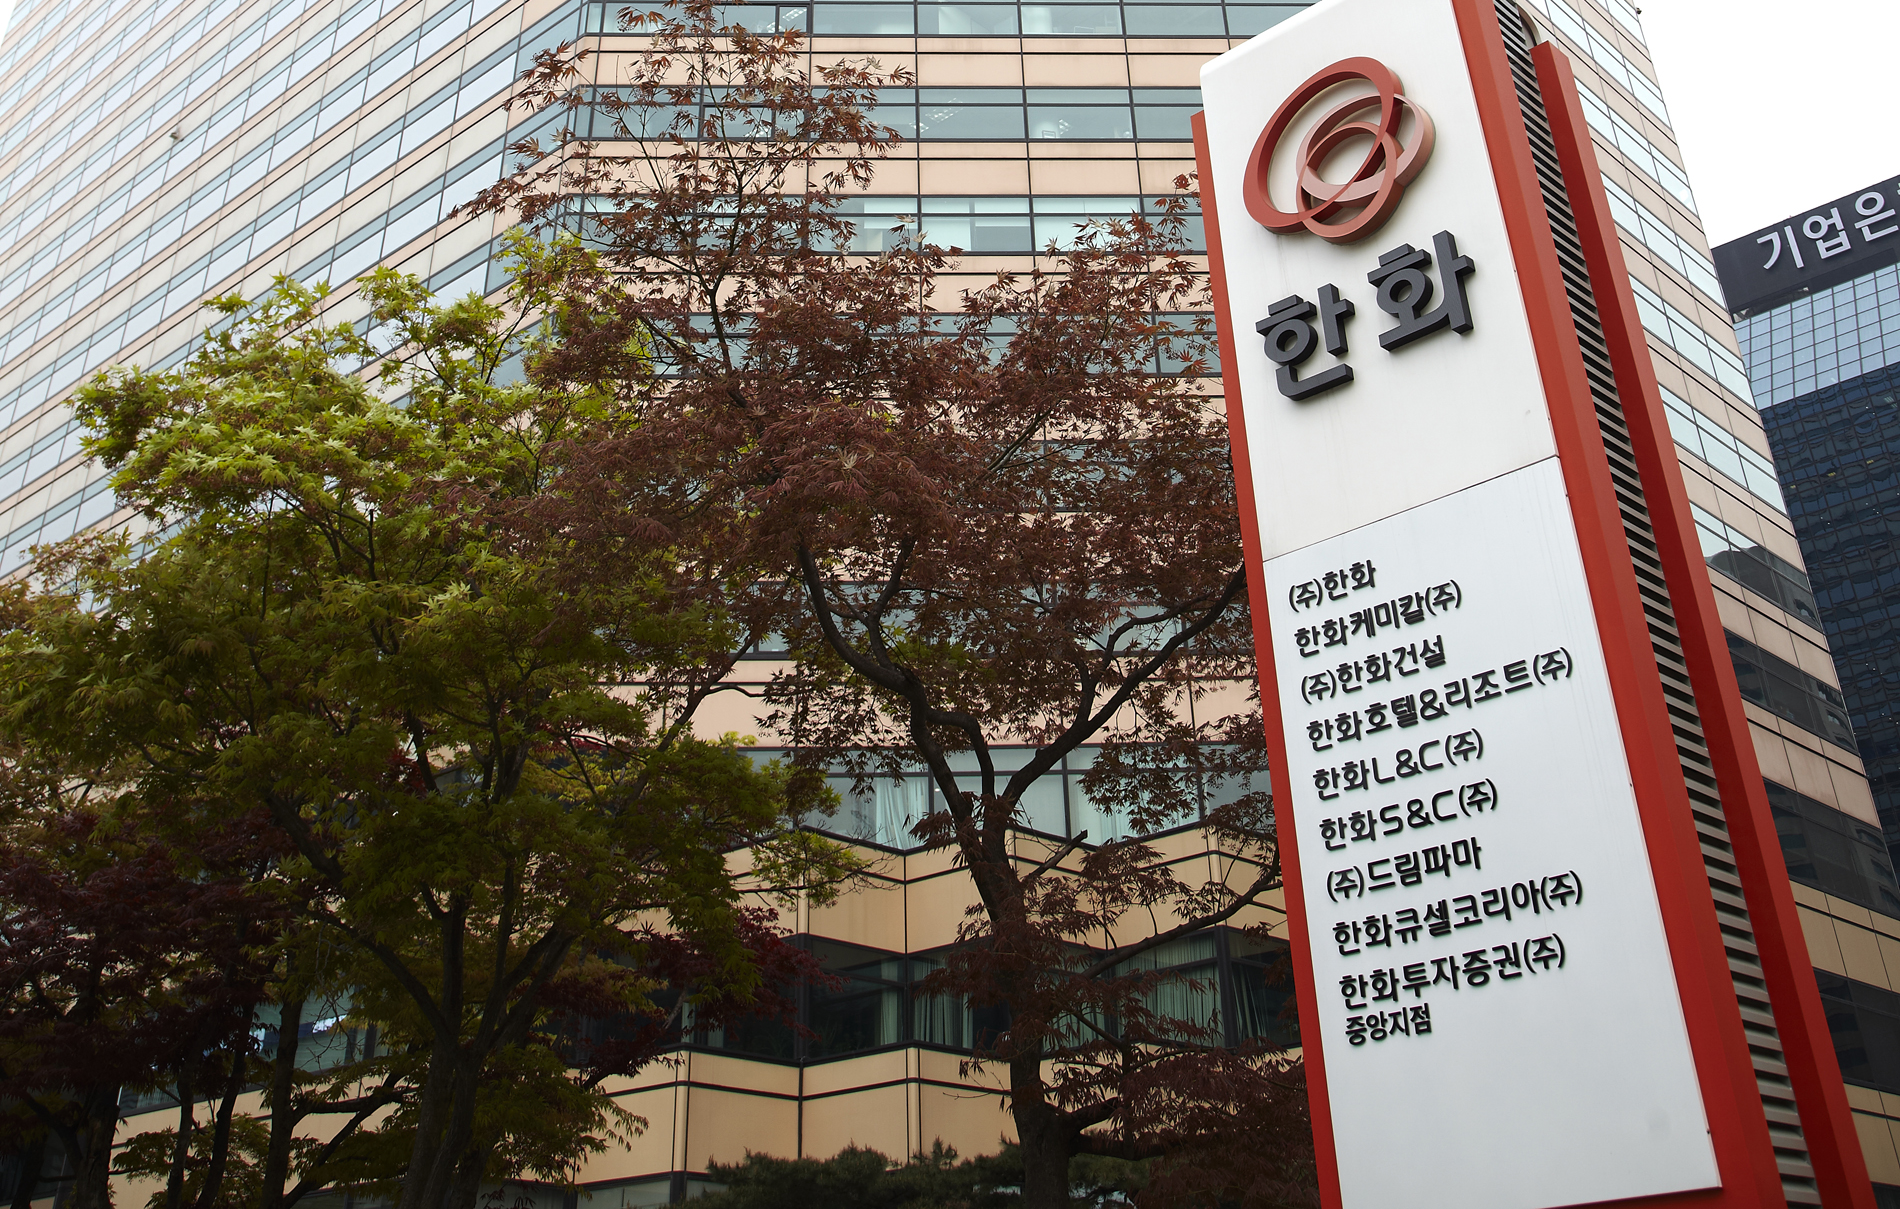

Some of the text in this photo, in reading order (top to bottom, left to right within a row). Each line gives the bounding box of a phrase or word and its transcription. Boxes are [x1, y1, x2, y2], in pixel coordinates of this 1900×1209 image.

[1756, 183, 1900, 270] 기업은
[1256, 229, 1476, 402] 한화
[1289, 560, 1376, 613] (주)한화
[1294, 580, 1462, 658] 한화케미칼(주)
[1302, 635, 1446, 704] (주)한화건설
[1307, 647, 1574, 752] 한화호텔&리조트(주)
[1313, 729, 1483, 801] 한화L&C(주)
[1319, 779, 1497, 851] 한화S&C(주)
[1327, 837, 1482, 903] (주)드림파마
[1333, 871, 1582, 956] 한화큐셀코리아(주)
[1339, 933, 1565, 1011] 한화투자증권(주)
[1346, 1003, 1432, 1046] 중앙지점
